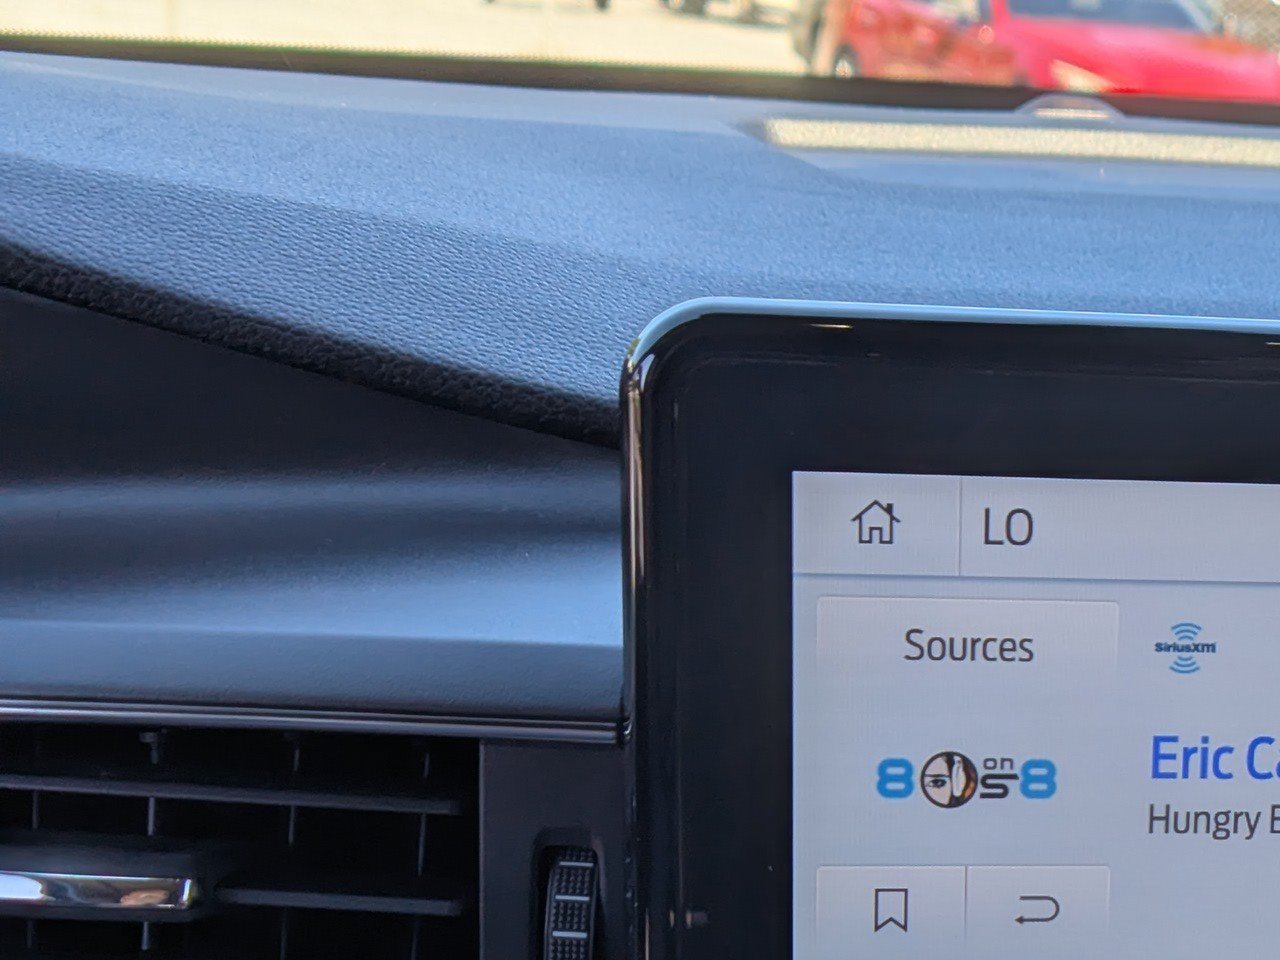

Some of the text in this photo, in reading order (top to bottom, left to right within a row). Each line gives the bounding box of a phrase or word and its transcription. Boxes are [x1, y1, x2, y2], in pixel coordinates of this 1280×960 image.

[982, 508, 1034, 545] LO
[904, 629, 1034, 662] Sources
[1151, 736, 1234, 780] Eric
[984, 758, 1013, 770] on
[1020, 759, 1056, 799] 8
[1148, 804, 1261, 840] Hungry
